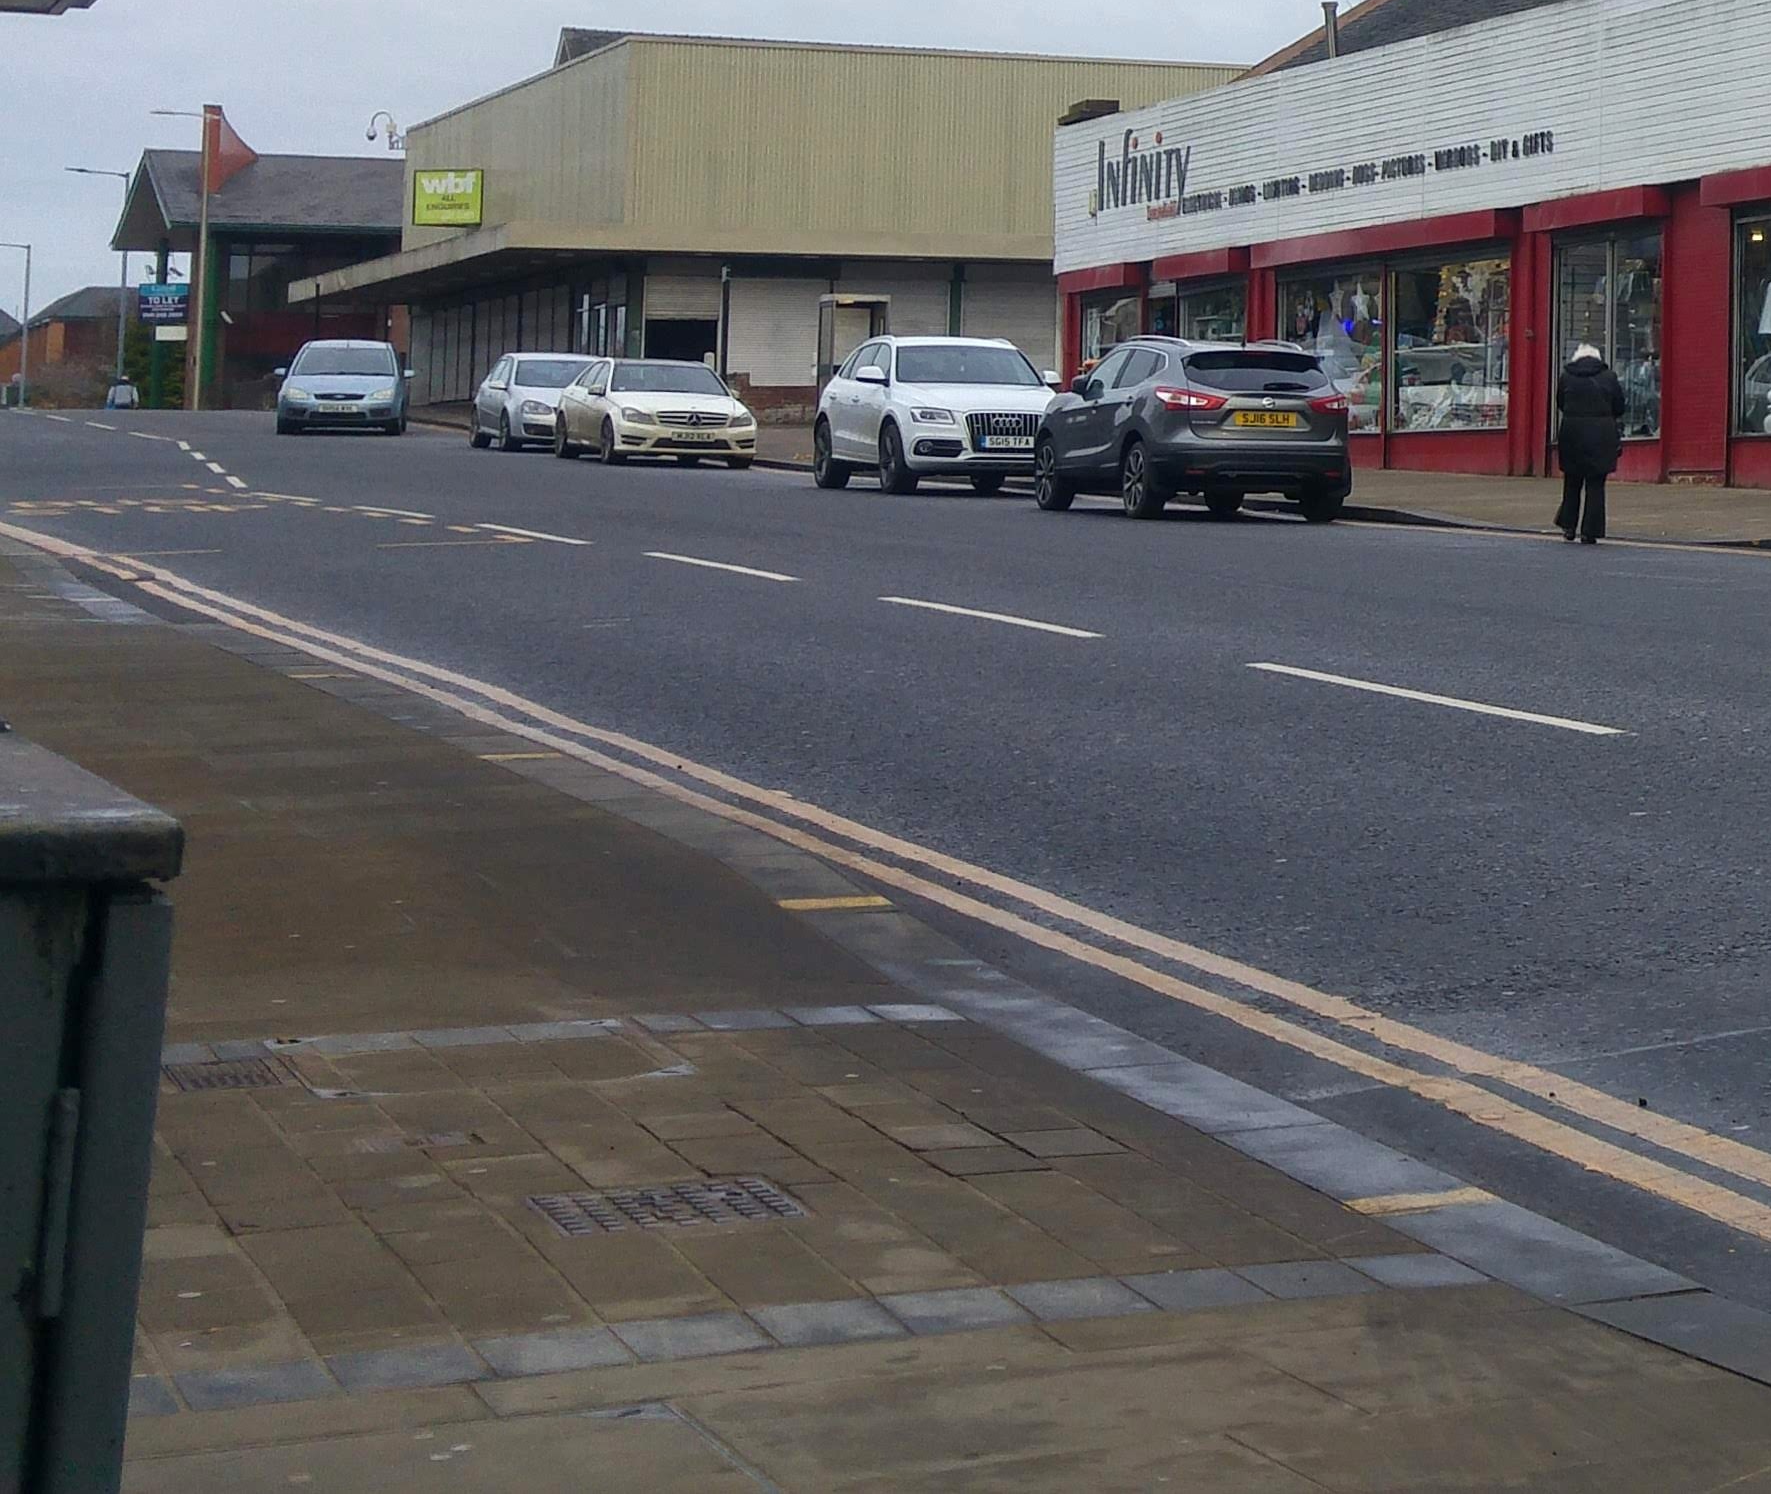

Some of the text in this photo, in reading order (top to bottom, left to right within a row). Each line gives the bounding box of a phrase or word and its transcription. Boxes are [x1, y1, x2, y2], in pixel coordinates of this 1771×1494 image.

[1523, 130, 1554, 156] GIFTS
[421, 171, 476, 194] wbf
[148, 296, 179, 305] TO LET
[1242, 412, 1290, 424] SJ16 SLH
[989, 437, 1030, 446] SG15 TFA
